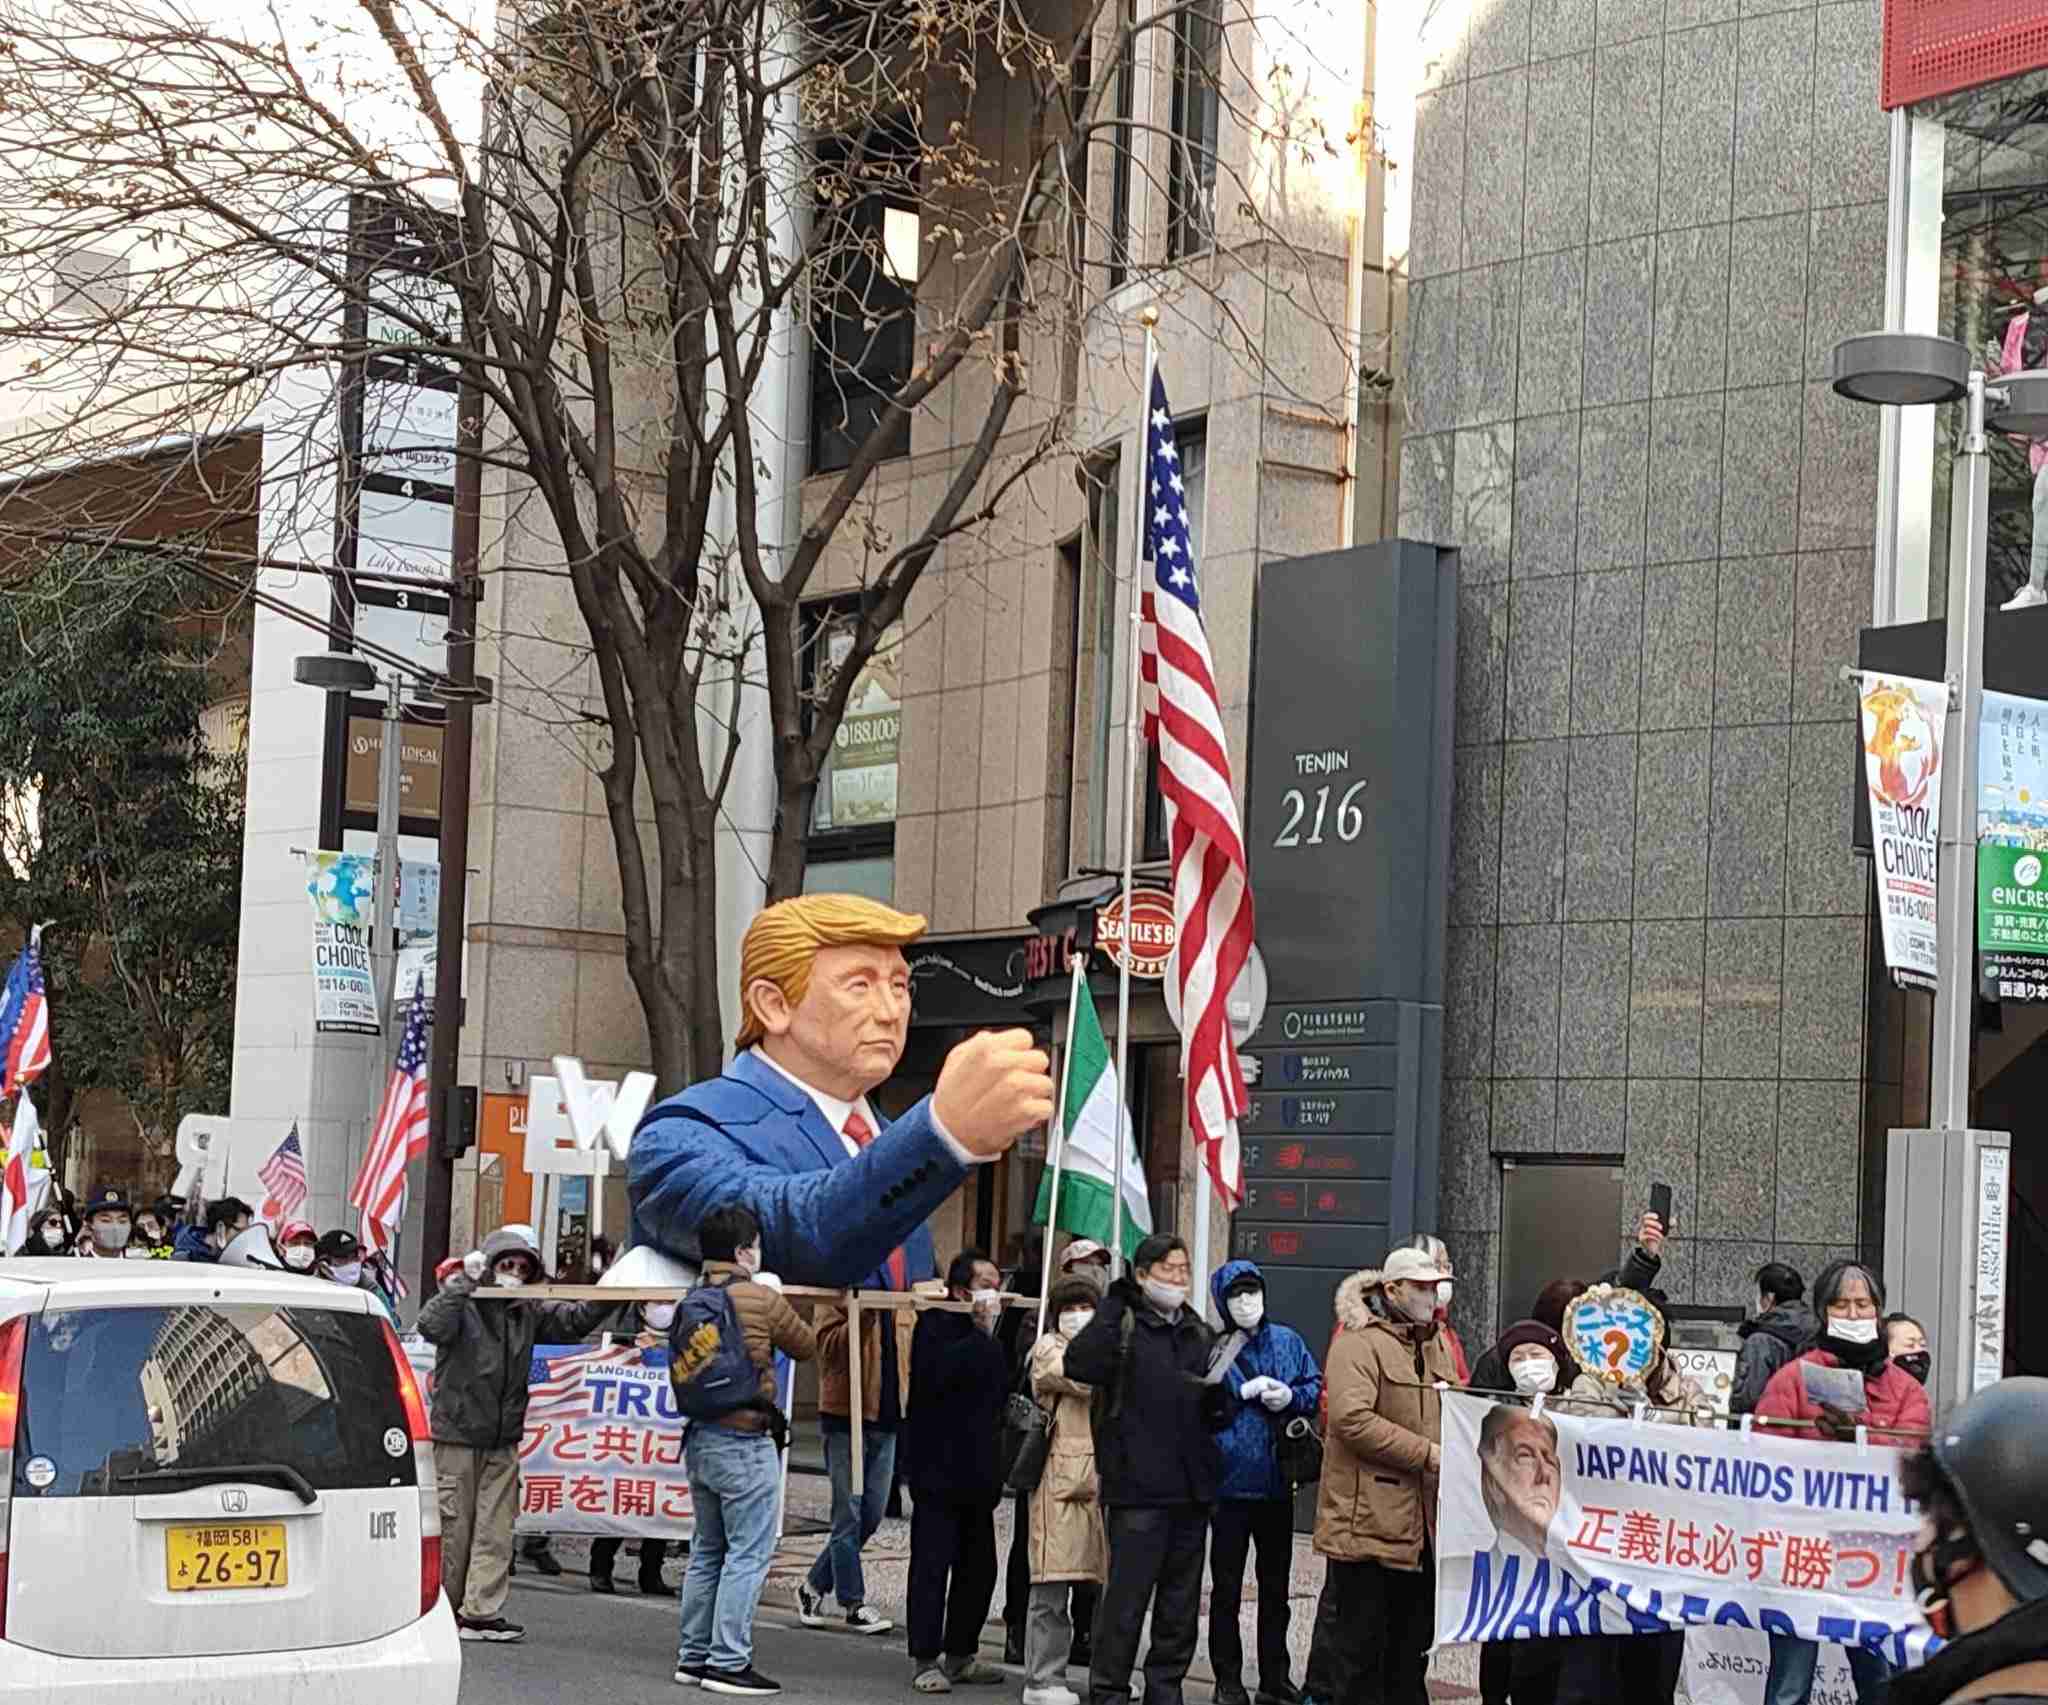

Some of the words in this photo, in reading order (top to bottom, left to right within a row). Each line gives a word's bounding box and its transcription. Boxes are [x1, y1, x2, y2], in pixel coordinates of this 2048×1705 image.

[400, 480, 414, 496] 4
[396, 592, 409, 608] 3
[1295, 750, 1350, 774] TENJIN
[1273, 779, 1368, 849] 216
[1882, 837, 1937, 884] CHOICE
[1097, 917, 1163, 945] SEATLE'S
[316, 945, 369, 971] CHOICE
[1242, 1147, 1260, 1168] 2F
[584, 1364, 667, 1382] LANDSLIDE
[584, 1379, 681, 1421] TRU
[1576, 1442, 1669, 1487] JAPAN
[1674, 1453, 1794, 1503] STANDS
[1803, 1468, 1890, 1514] WITH
[194, 1550, 282, 1584] 26-97
